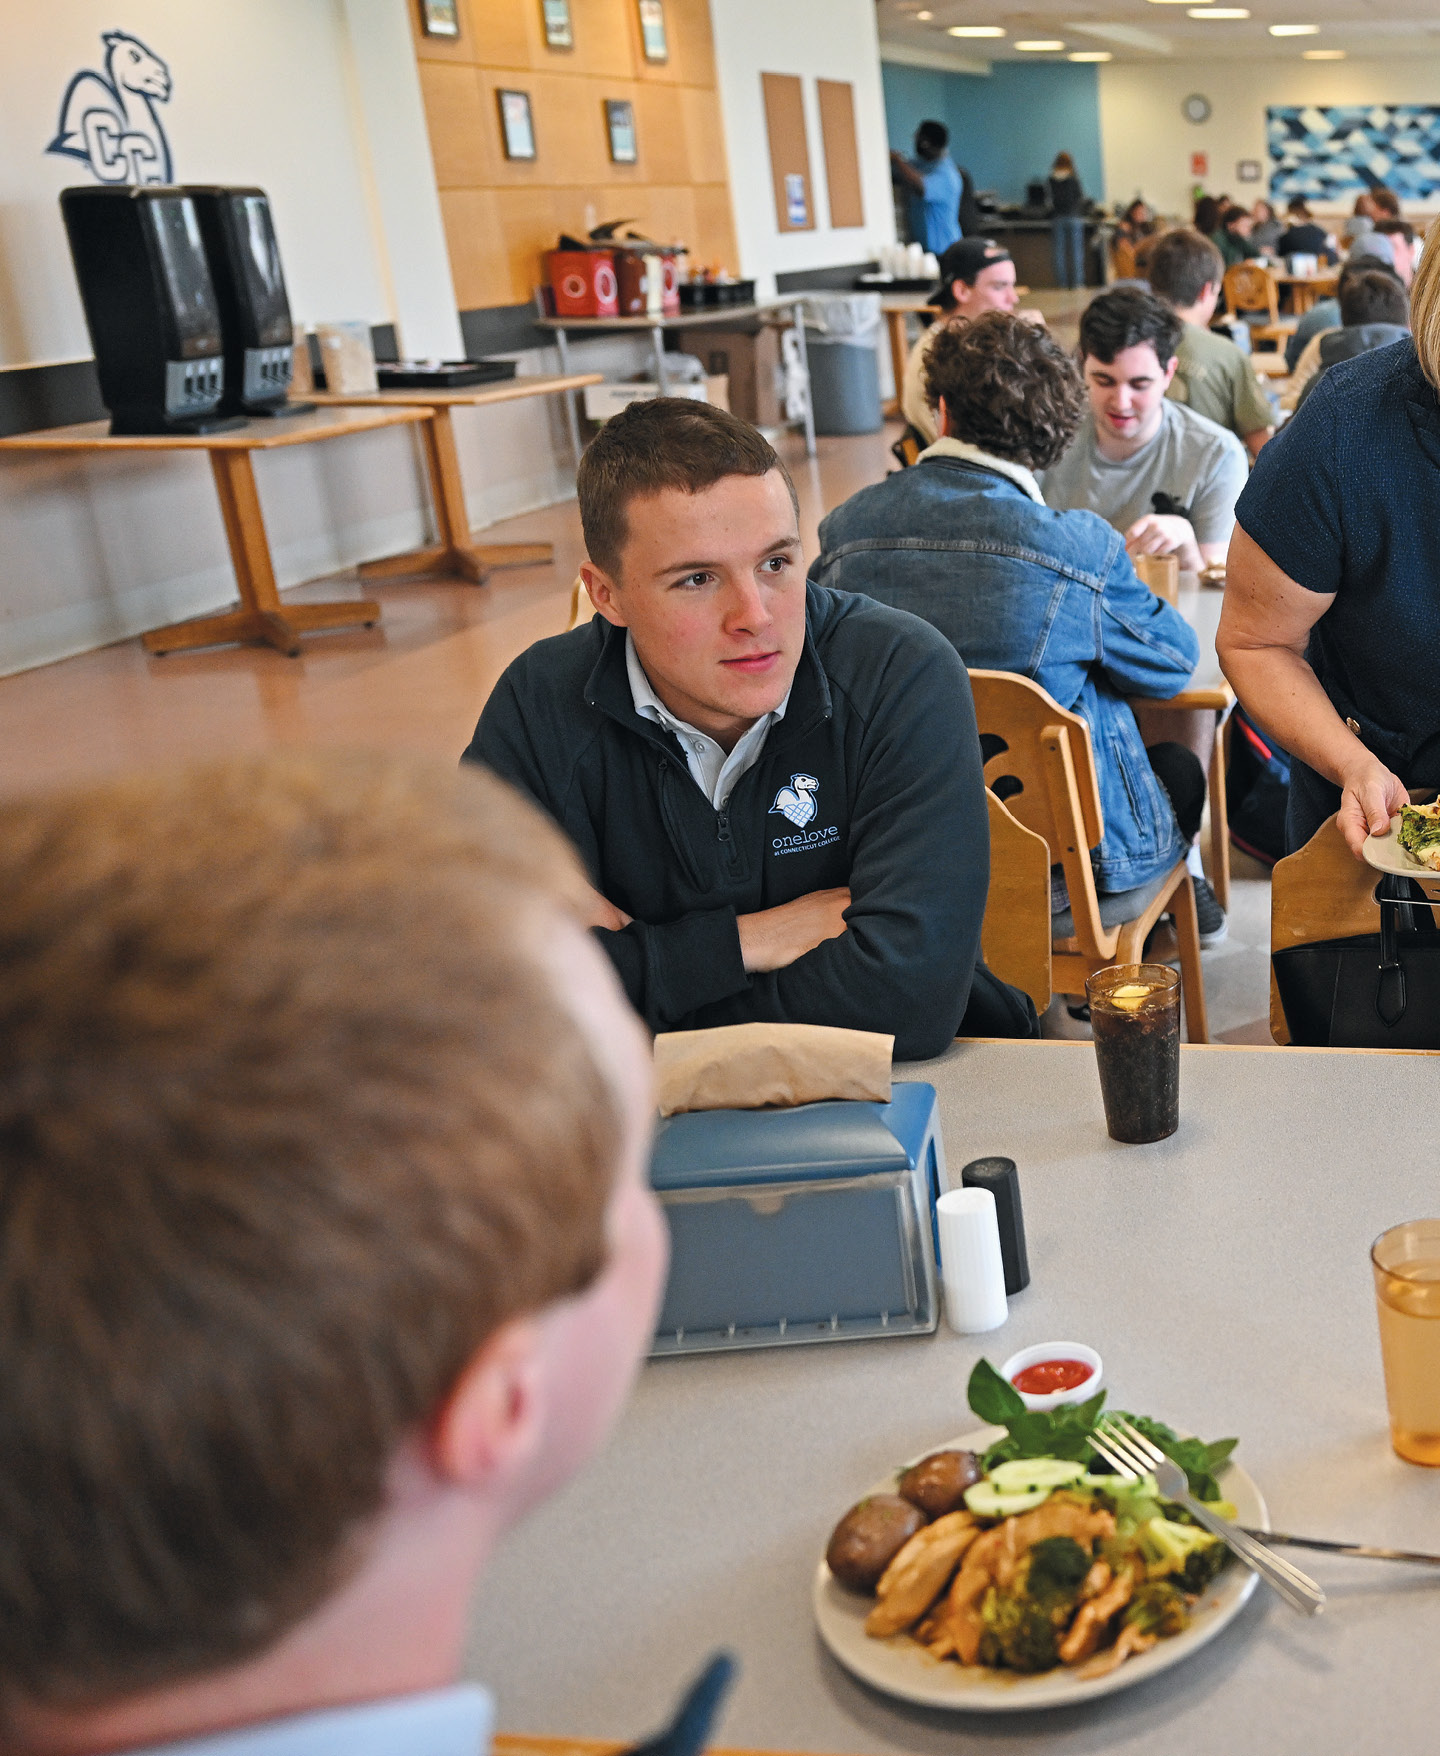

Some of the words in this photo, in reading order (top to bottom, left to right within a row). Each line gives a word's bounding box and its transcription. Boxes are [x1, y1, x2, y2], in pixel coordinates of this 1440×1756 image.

[772, 826, 839, 849] onelove
[780, 843, 817, 855] CONNECTICUT
[817, 835, 841, 847] COLLEGE
